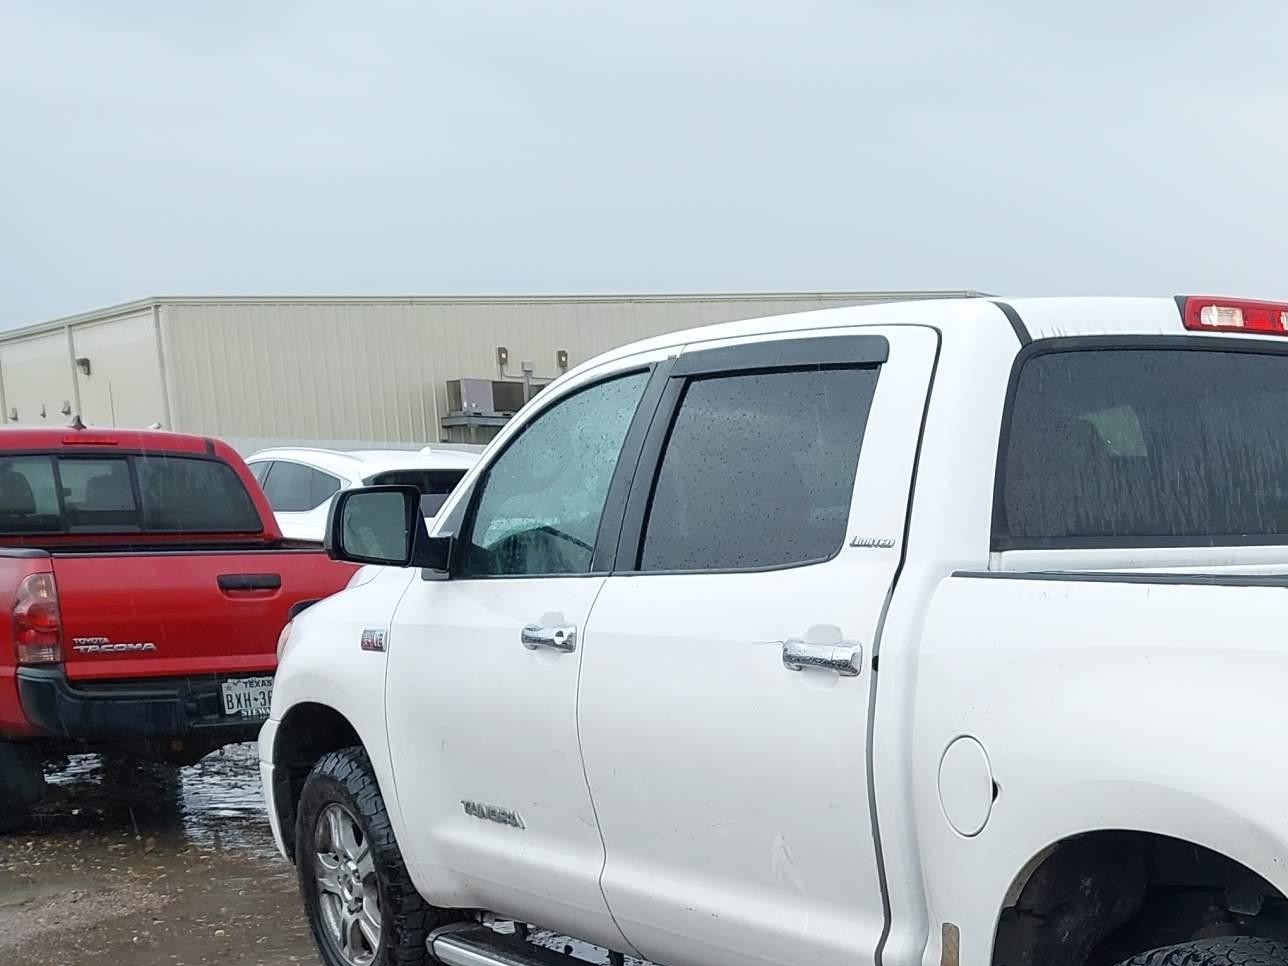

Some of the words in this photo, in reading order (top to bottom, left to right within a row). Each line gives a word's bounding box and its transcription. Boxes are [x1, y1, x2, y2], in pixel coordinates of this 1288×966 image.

[72, 637, 110, 645] TOYOTA
[72, 643, 157, 653] TACOMA
[243, 679, 273, 689] TEXAS
